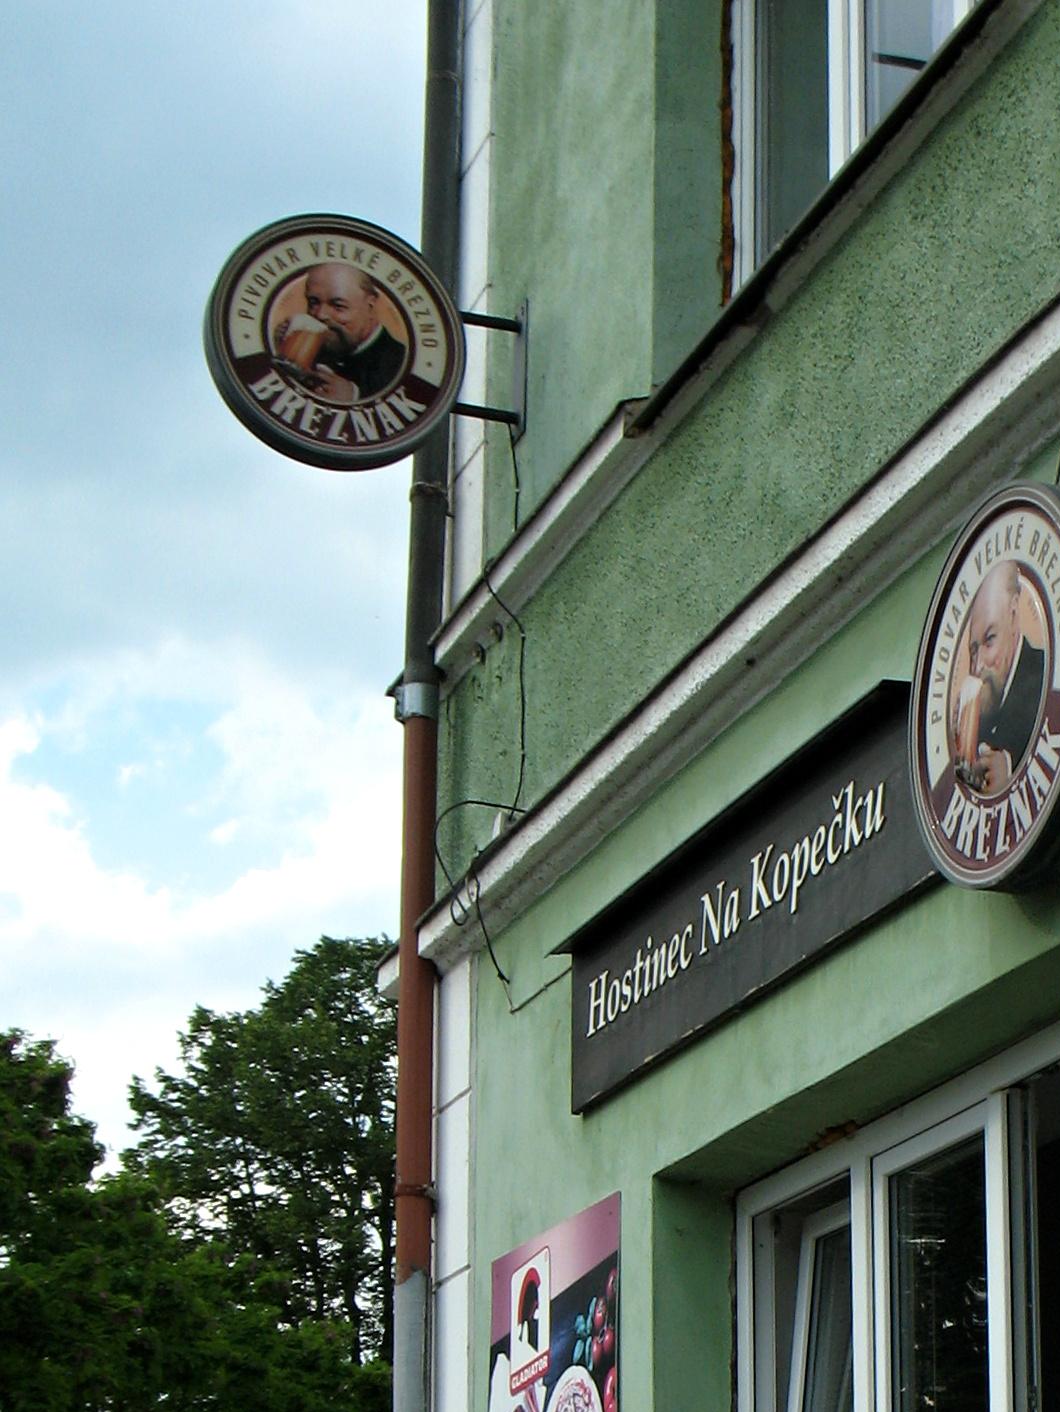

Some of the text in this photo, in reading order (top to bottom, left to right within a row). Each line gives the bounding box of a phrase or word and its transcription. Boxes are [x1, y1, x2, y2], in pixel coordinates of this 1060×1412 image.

[238, 240, 438, 349] PIVOVAR VELKÉ BŘEZNO
[931, 581, 970, 726] PIVOVAR
[974, 516, 1025, 574] VELKÉ
[586, 780, 885, 1038] Hostinec Na Kopečku
[511, 1355, 548, 1389] GLADIATOR
